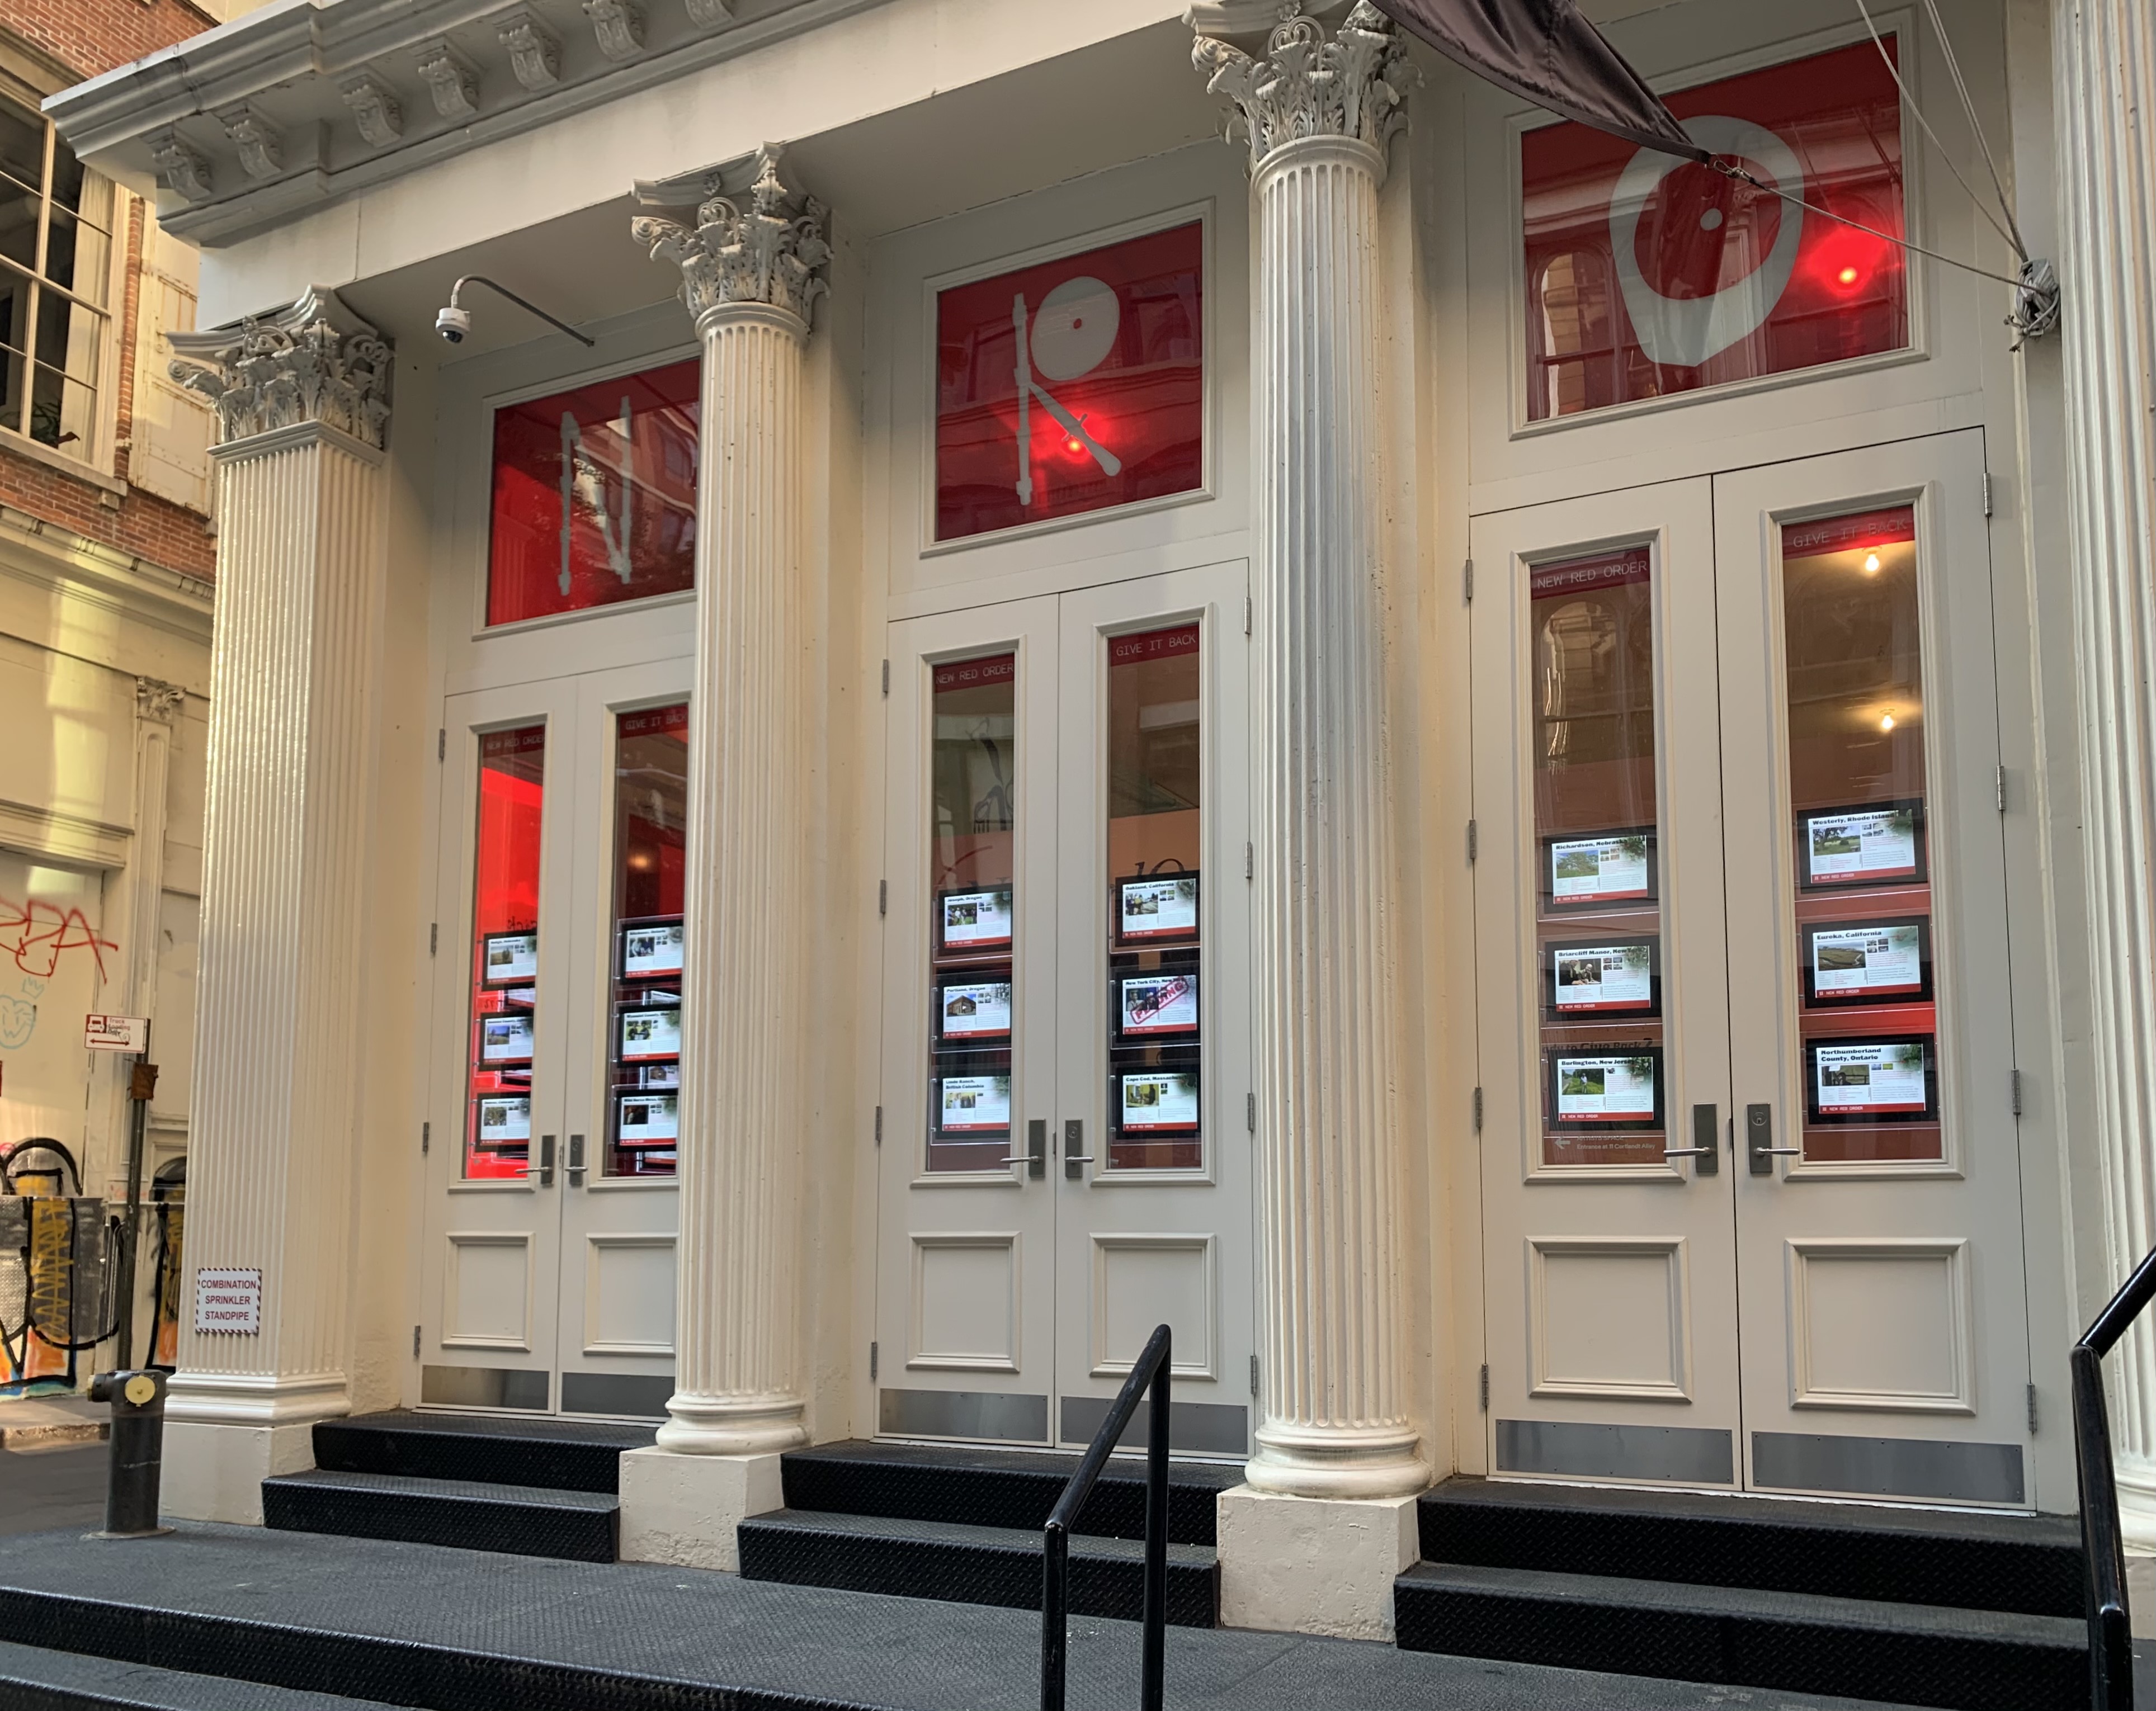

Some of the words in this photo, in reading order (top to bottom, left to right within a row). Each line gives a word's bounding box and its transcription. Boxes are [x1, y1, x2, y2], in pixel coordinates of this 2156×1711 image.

[1793, 530, 1830, 547] GIVE
[1840, 526, 1860, 540] IT
[1869, 518, 1907, 538] BACK
[1537, 573, 1563, 589] NEW
[1570, 568, 1596, 583] RED
[1603, 560, 1647, 578] ORDER
[1116, 642, 1143, 656] GIVE
[1149, 640, 1162, 651] IT
[1169, 634, 1196, 647] BACK
[936, 673, 955, 684] NEW
[959, 669, 978, 680] RED
[982, 663, 1013, 677] ORDER
[625, 719, 646, 730] GIVE
[201, 1280, 256, 1289] COMBINATION
[205, 1296, 251, 1304] SPRINKLER
[205, 1311, 249, 1321] STANDPIPE
